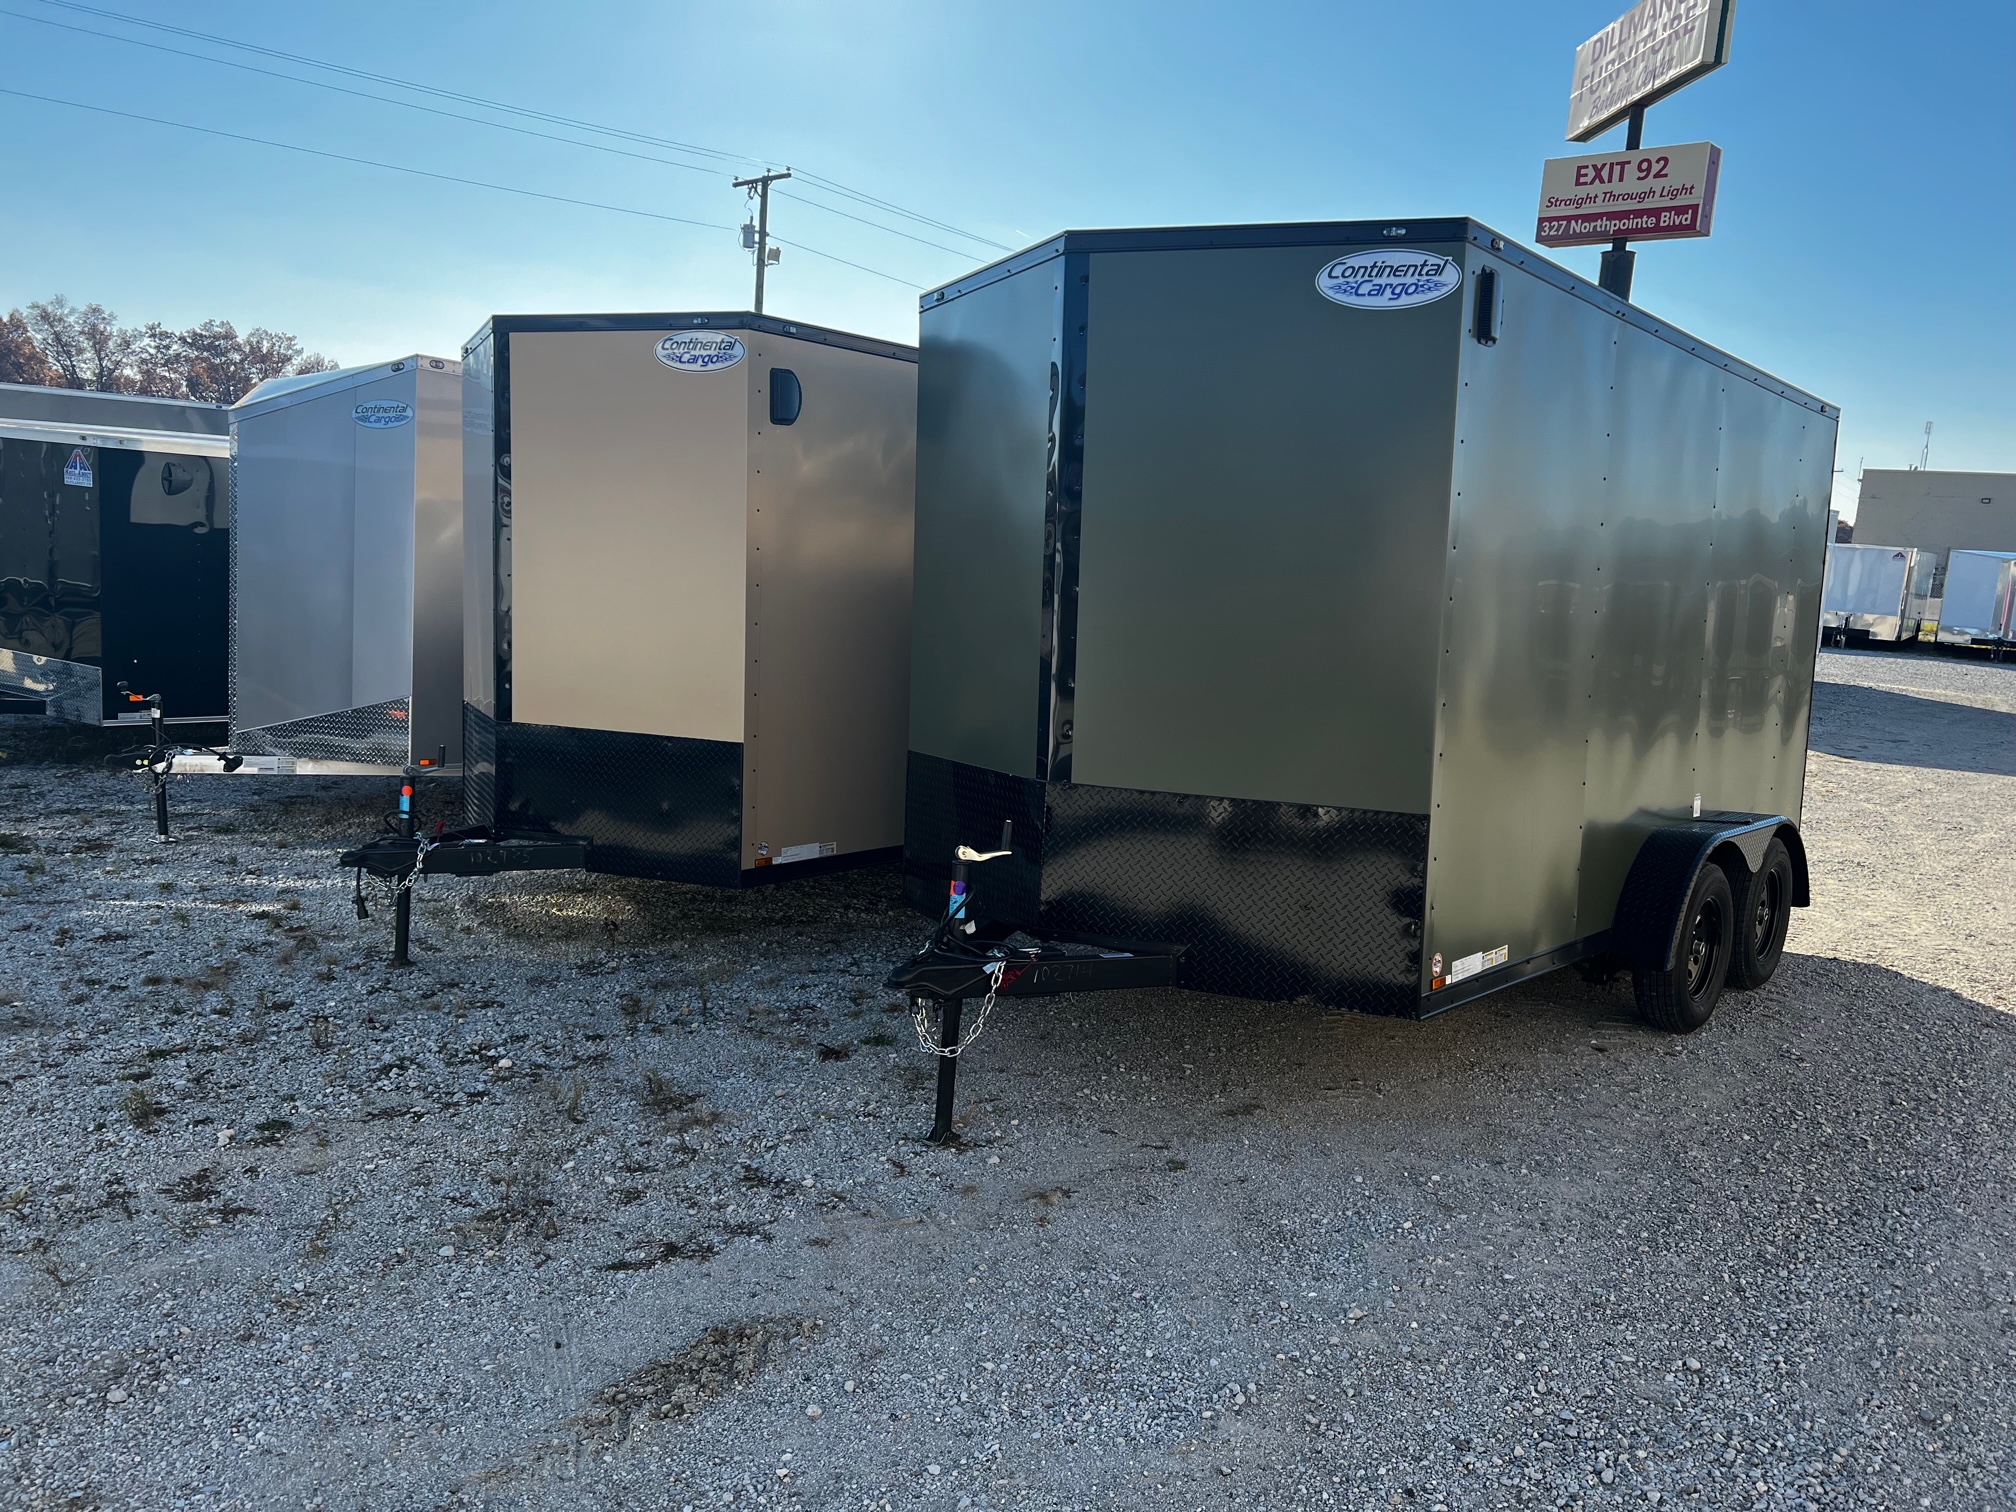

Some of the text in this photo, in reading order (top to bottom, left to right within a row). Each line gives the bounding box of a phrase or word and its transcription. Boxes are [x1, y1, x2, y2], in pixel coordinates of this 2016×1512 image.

[1591, 0, 1687, 66] DILLMAN
[1579, 2, 1698, 103] FURNITURE
[1574, 156, 1670, 187] EXIT 92
[1545, 183, 1695, 209] Straight Through Light
[1540, 209, 1693, 236] 327 Northpointe Blvd
[1327, 257, 1451, 279] Continental
[1352, 280, 1420, 301] Cargo
[661, 337, 738, 351] Continental
[678, 352, 720, 367] Cargo
[355, 404, 408, 414] Continental
[367, 414, 396, 425] Cargo
